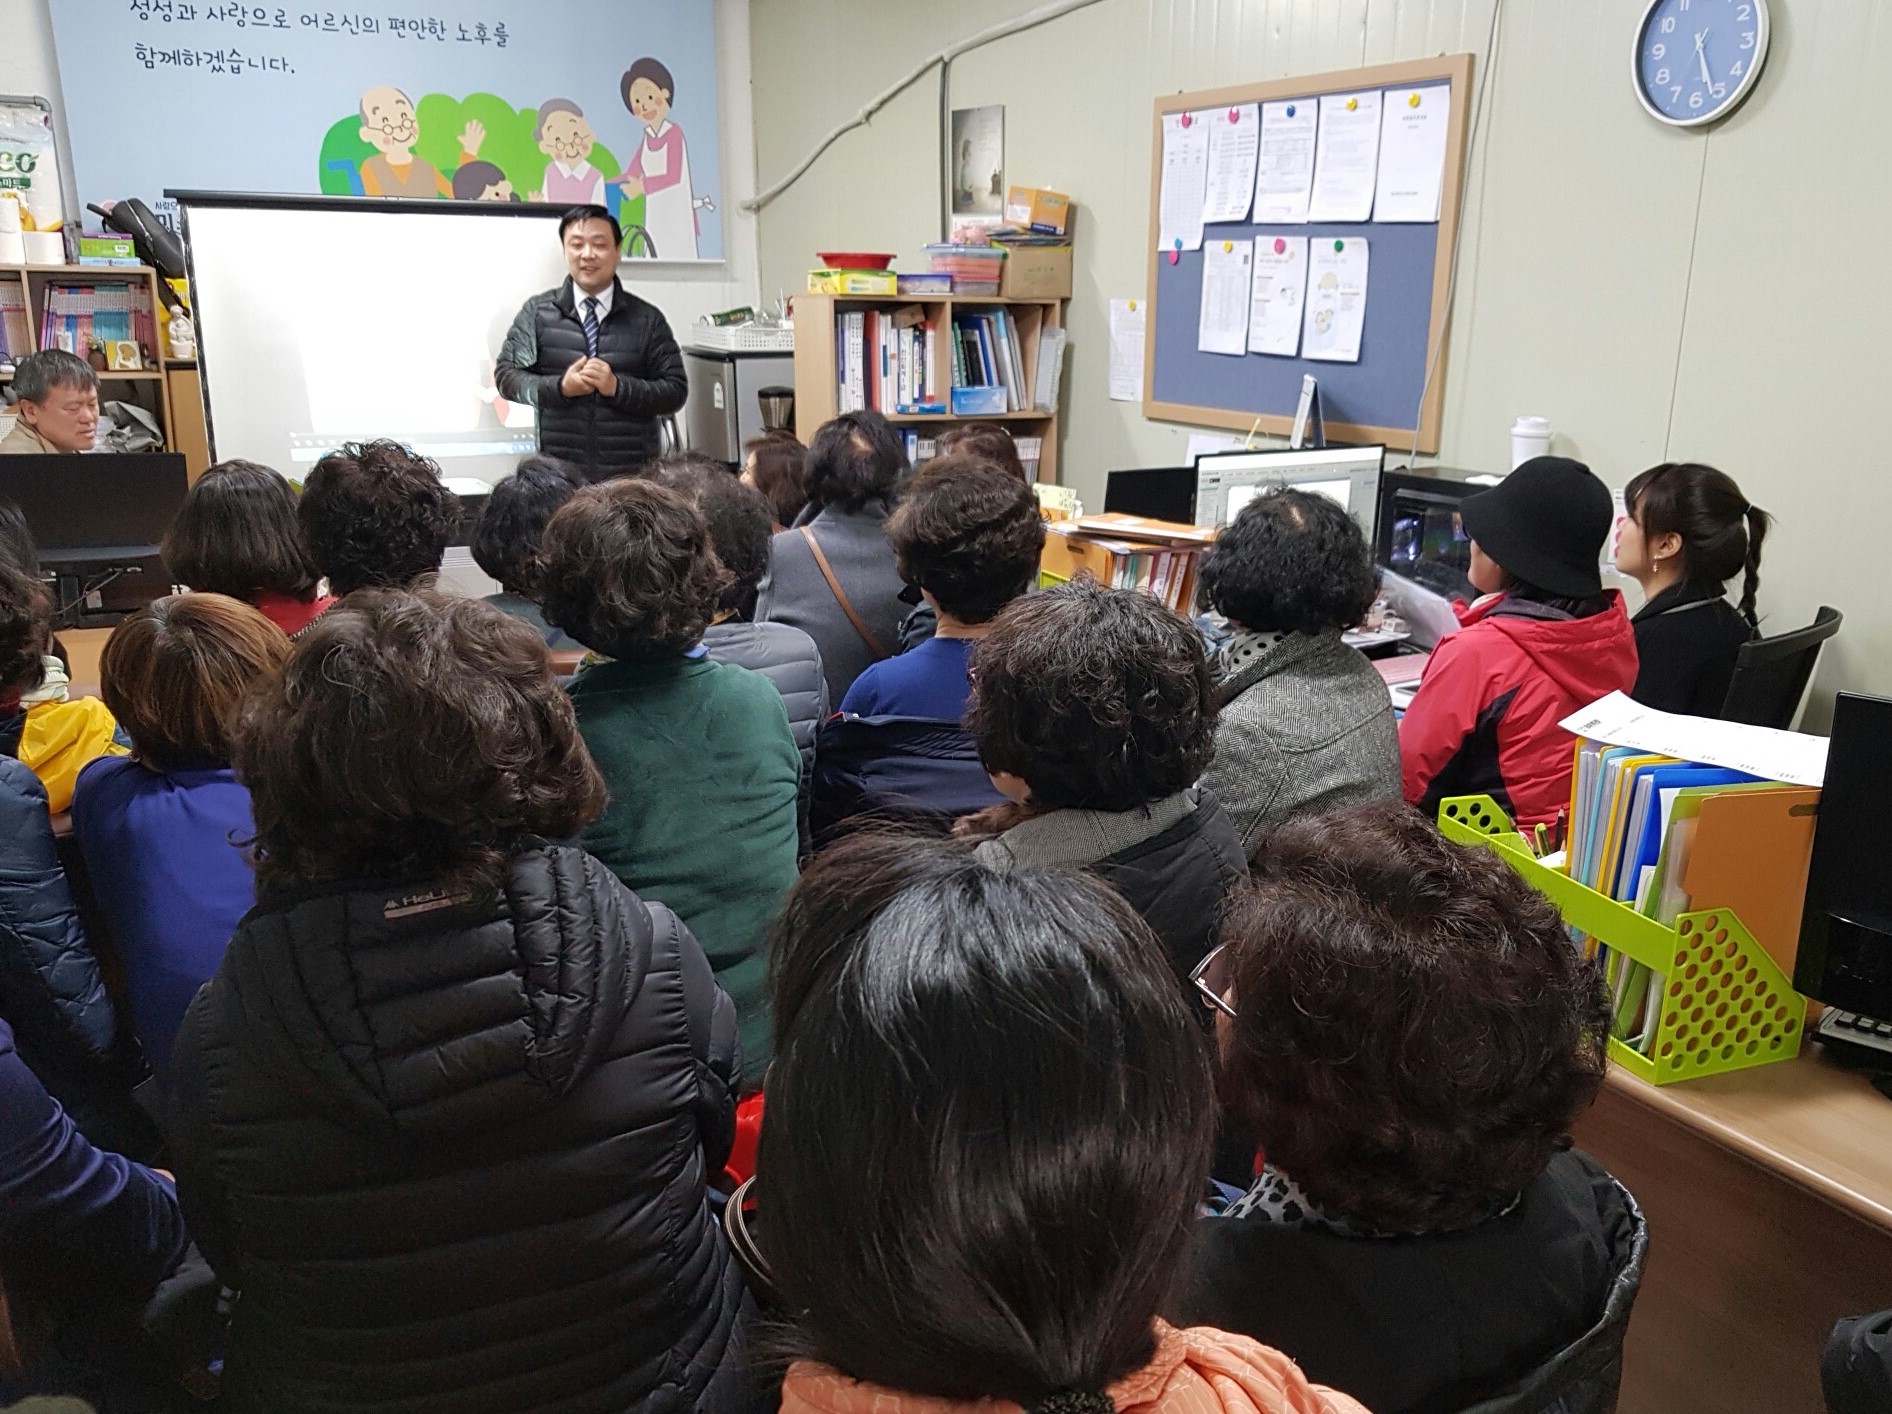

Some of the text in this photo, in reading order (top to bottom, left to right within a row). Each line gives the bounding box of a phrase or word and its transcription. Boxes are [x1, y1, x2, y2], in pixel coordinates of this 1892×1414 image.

[1736, 4, 1751, 21] 2
[206, 2, 291, 28] 사랑으로
[300, 13, 379, 36] 어르신의
[388, 17, 447, 41] 편안한
[456, 22, 509, 48] 노후를
[1661, 16, 1676, 34] 10
[1739, 31, 1755, 49] 3
[134, 43, 296, 75] 함께하겠습니다.
[1651, 43, 1666, 61] 9
[1655, 68, 1670, 85] 8
[1729, 60, 1743, 77] 4
[1670, 85, 1682, 104] 7
[1711, 82, 1726, 99] 5
[1688, 91, 1704, 109] 6
